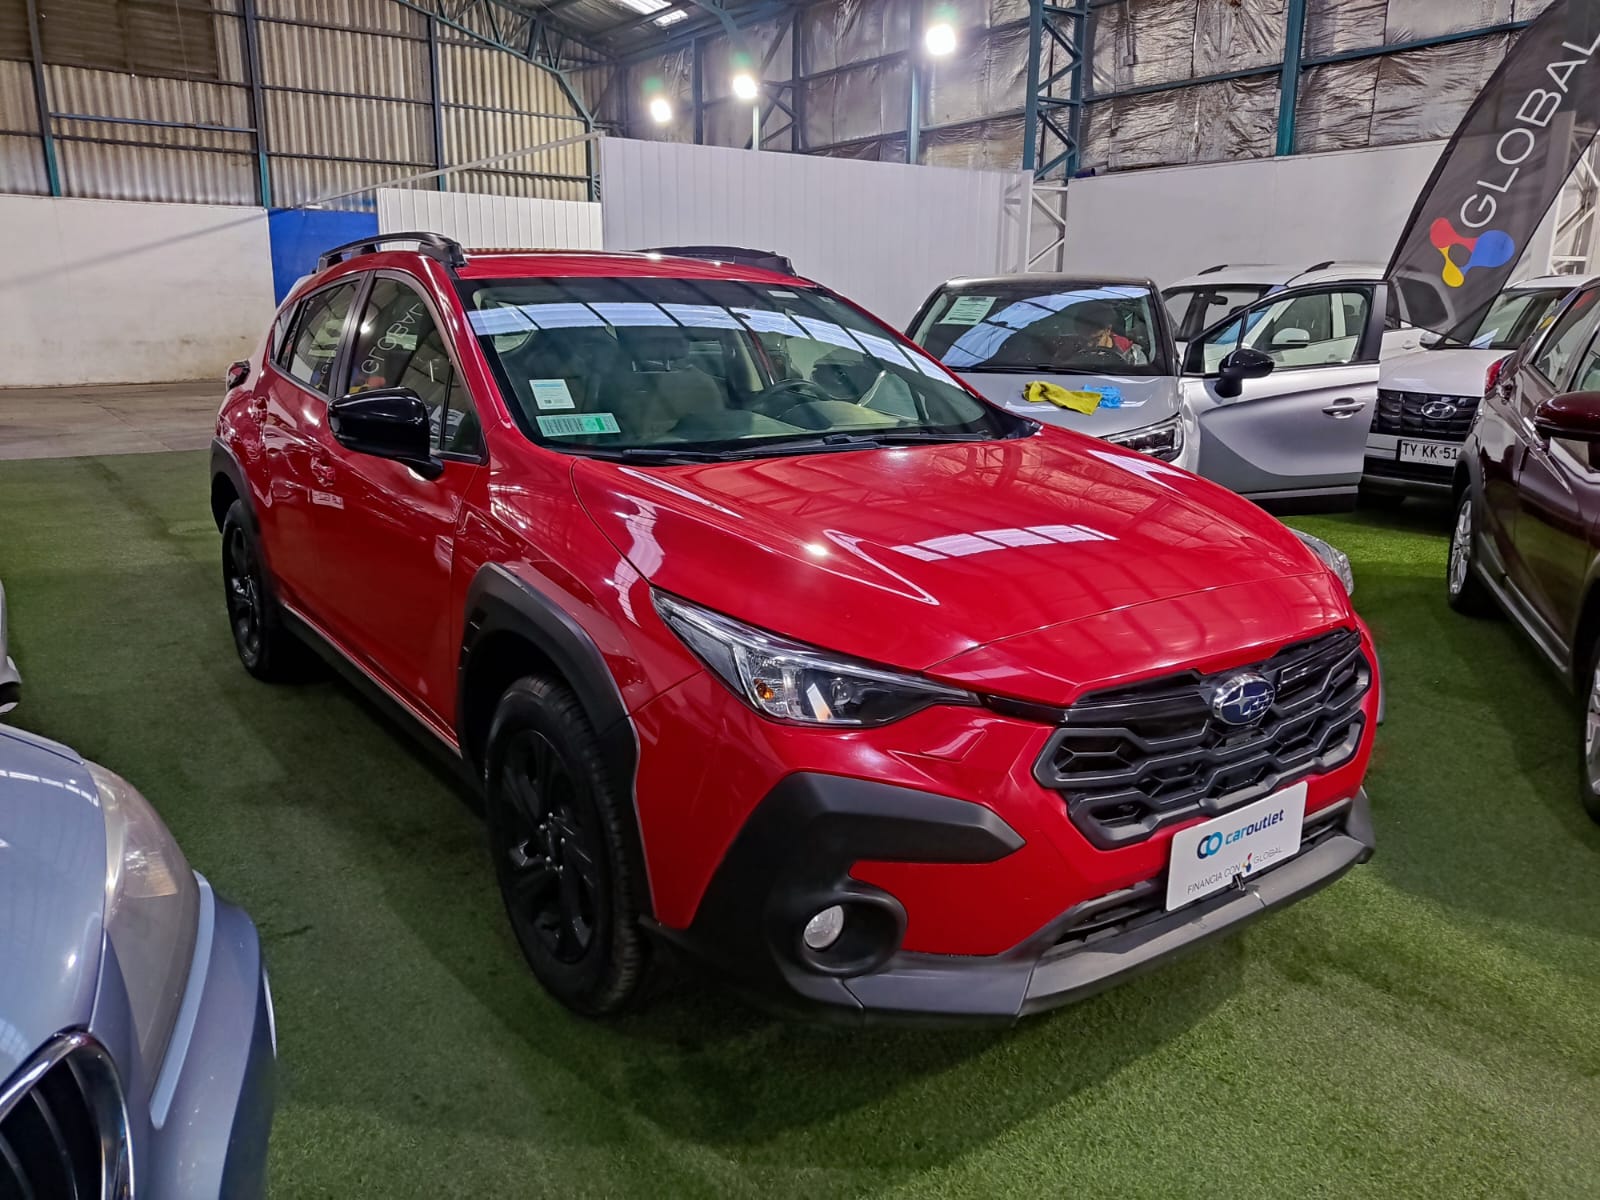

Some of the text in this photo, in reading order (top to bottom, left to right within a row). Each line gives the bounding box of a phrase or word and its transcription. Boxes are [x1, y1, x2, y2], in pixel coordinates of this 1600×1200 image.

[1460, 33, 1600, 229] GLOBAL
[1402, 443, 1457, 460] TY KK 51
[1225, 809, 1284, 845] caroutlet
[1187, 846, 1283, 895] FINANCIA CON GLOBAL
